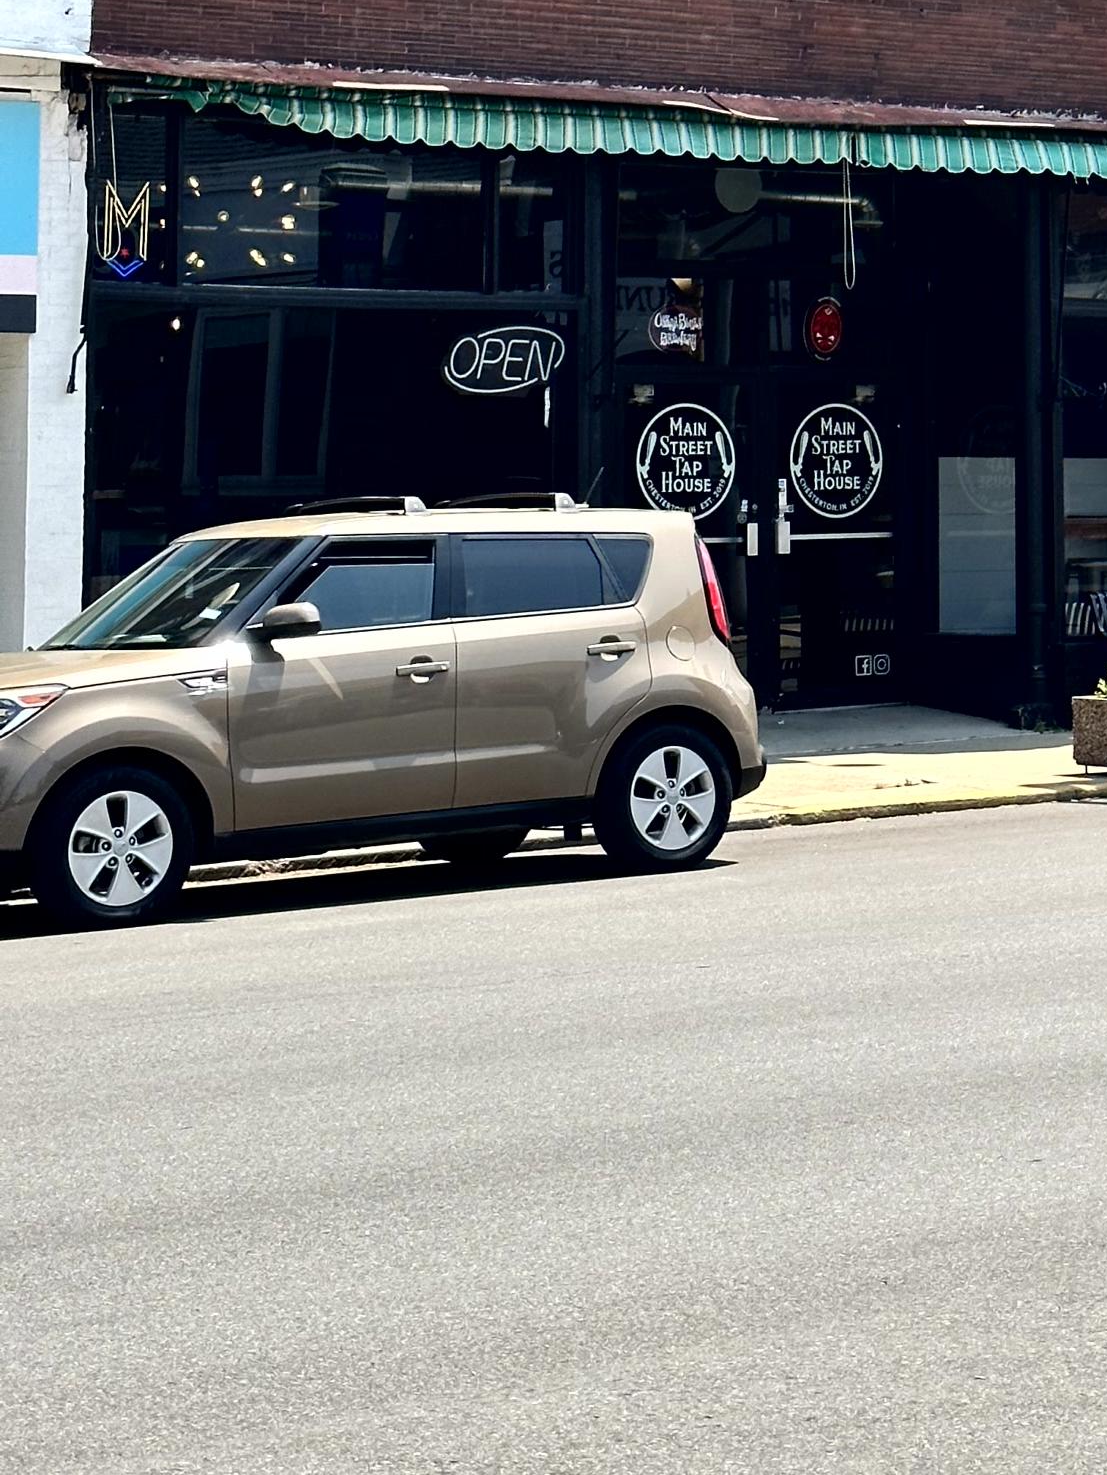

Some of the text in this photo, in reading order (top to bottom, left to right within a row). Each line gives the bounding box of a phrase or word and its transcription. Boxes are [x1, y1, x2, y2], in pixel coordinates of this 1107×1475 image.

[449, 336, 559, 382] OPEN
[669, 417, 707, 436] MAIN
[820, 417, 856, 436] MAIN
[660, 435, 714, 456] STREET
[811, 435, 862, 455] STREET
[671, 456, 703, 477] TAP
[822, 455, 852, 475] TAP
[661, 471, 712, 493] HOUSE
[813, 470, 861, 491] HOUSE
